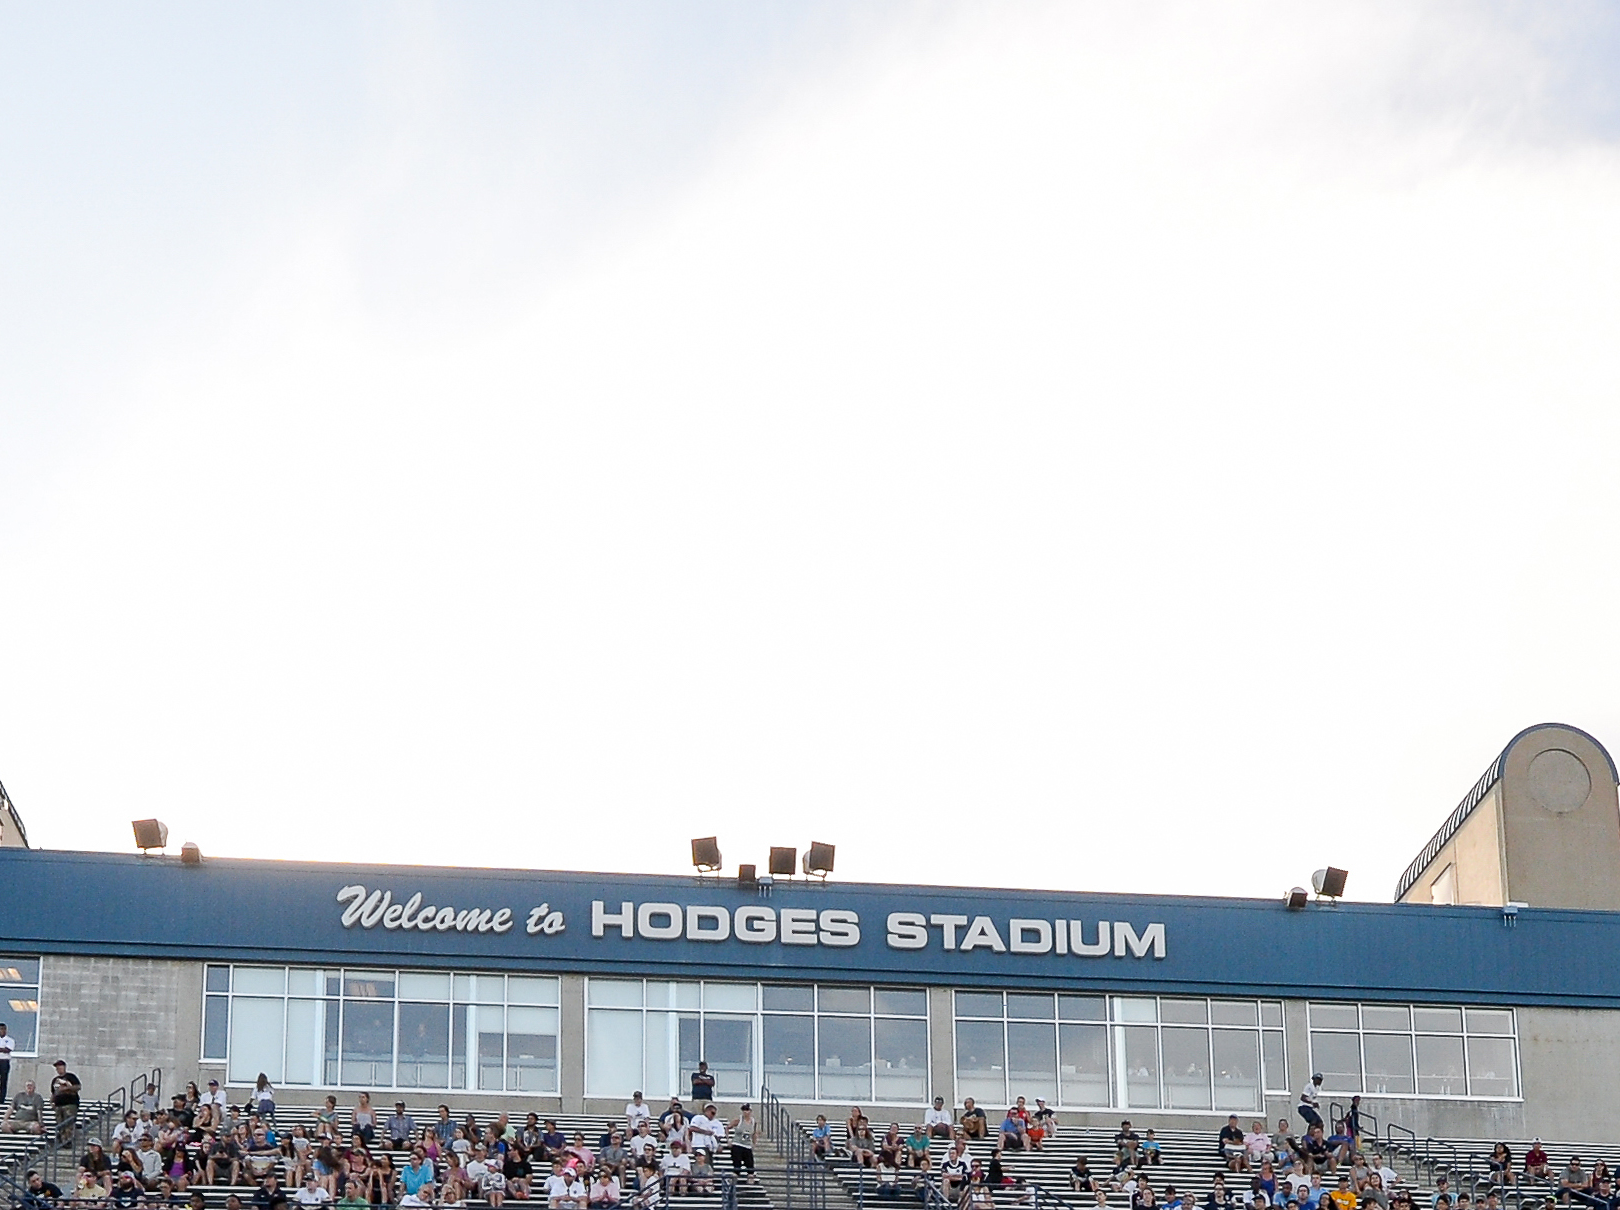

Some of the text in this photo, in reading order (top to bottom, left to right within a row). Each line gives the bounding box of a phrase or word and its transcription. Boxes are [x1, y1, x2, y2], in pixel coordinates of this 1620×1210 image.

[336, 885, 1167, 958] Welcome to HODGES STADIUM
